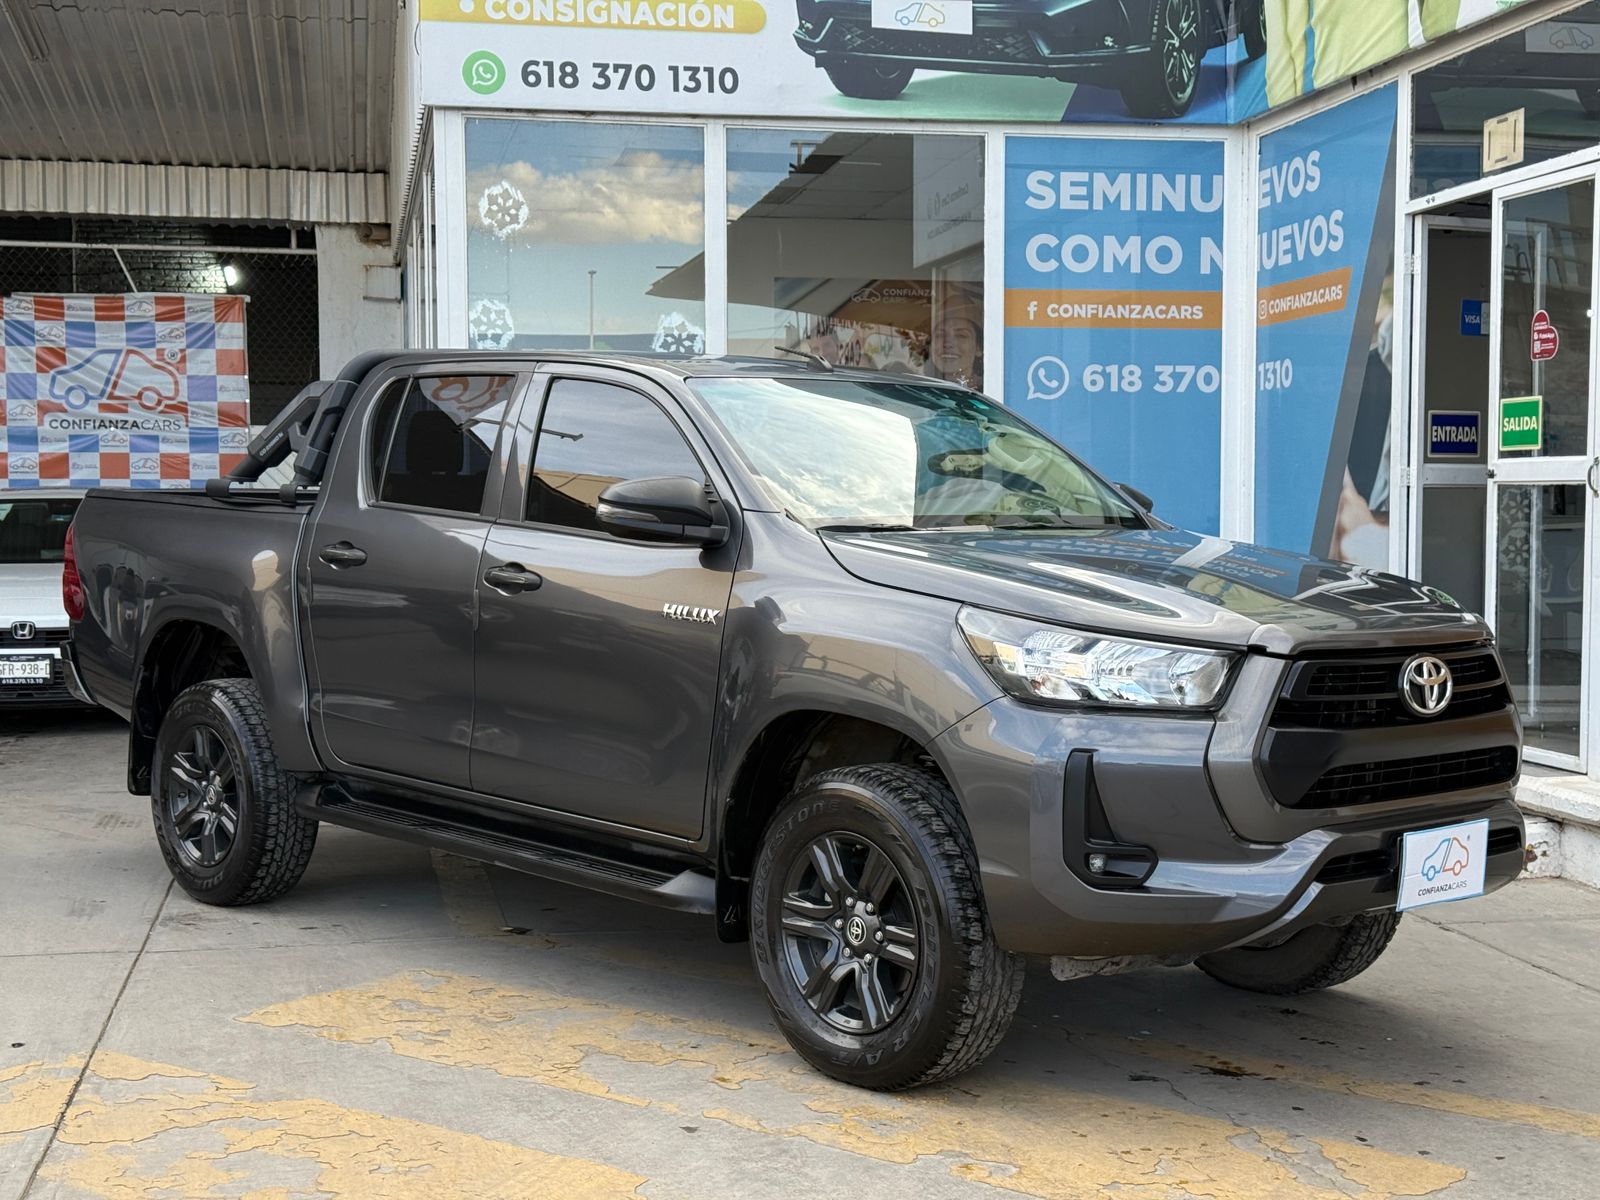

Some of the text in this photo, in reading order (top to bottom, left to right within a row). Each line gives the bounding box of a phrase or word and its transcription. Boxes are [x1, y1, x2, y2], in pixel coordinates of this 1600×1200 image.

[484, 0, 735, 29] CONSIGNACIÓN
[520, 60, 739, 94] 618 370 1310
[1025, 170, 1224, 213] SEMINU
[1258, 209, 1344, 272] UEVOS
[1025, 233, 1183, 274] COMO
[883, 288, 936, 297] CONFIANZA
[1268, 284, 1344, 315] CONFIANZACARS
[1047, 303, 1204, 320] CONFIANZACARS
[1464, 314, 1481, 324] VISA
[1082, 363, 1221, 394] 618 370
[1258, 358, 1293, 391] 1310
[49, 418, 182, 431] CONFIANZACARS
[1431, 425, 1477, 443] ENTRADA
[1503, 415, 1538, 432] SALIDA
[662, 603, 720, 625] HILUX
[0, 663, 50, 676] FR-938-D
[1417, 879, 1468, 897] CONFIANZACARS
